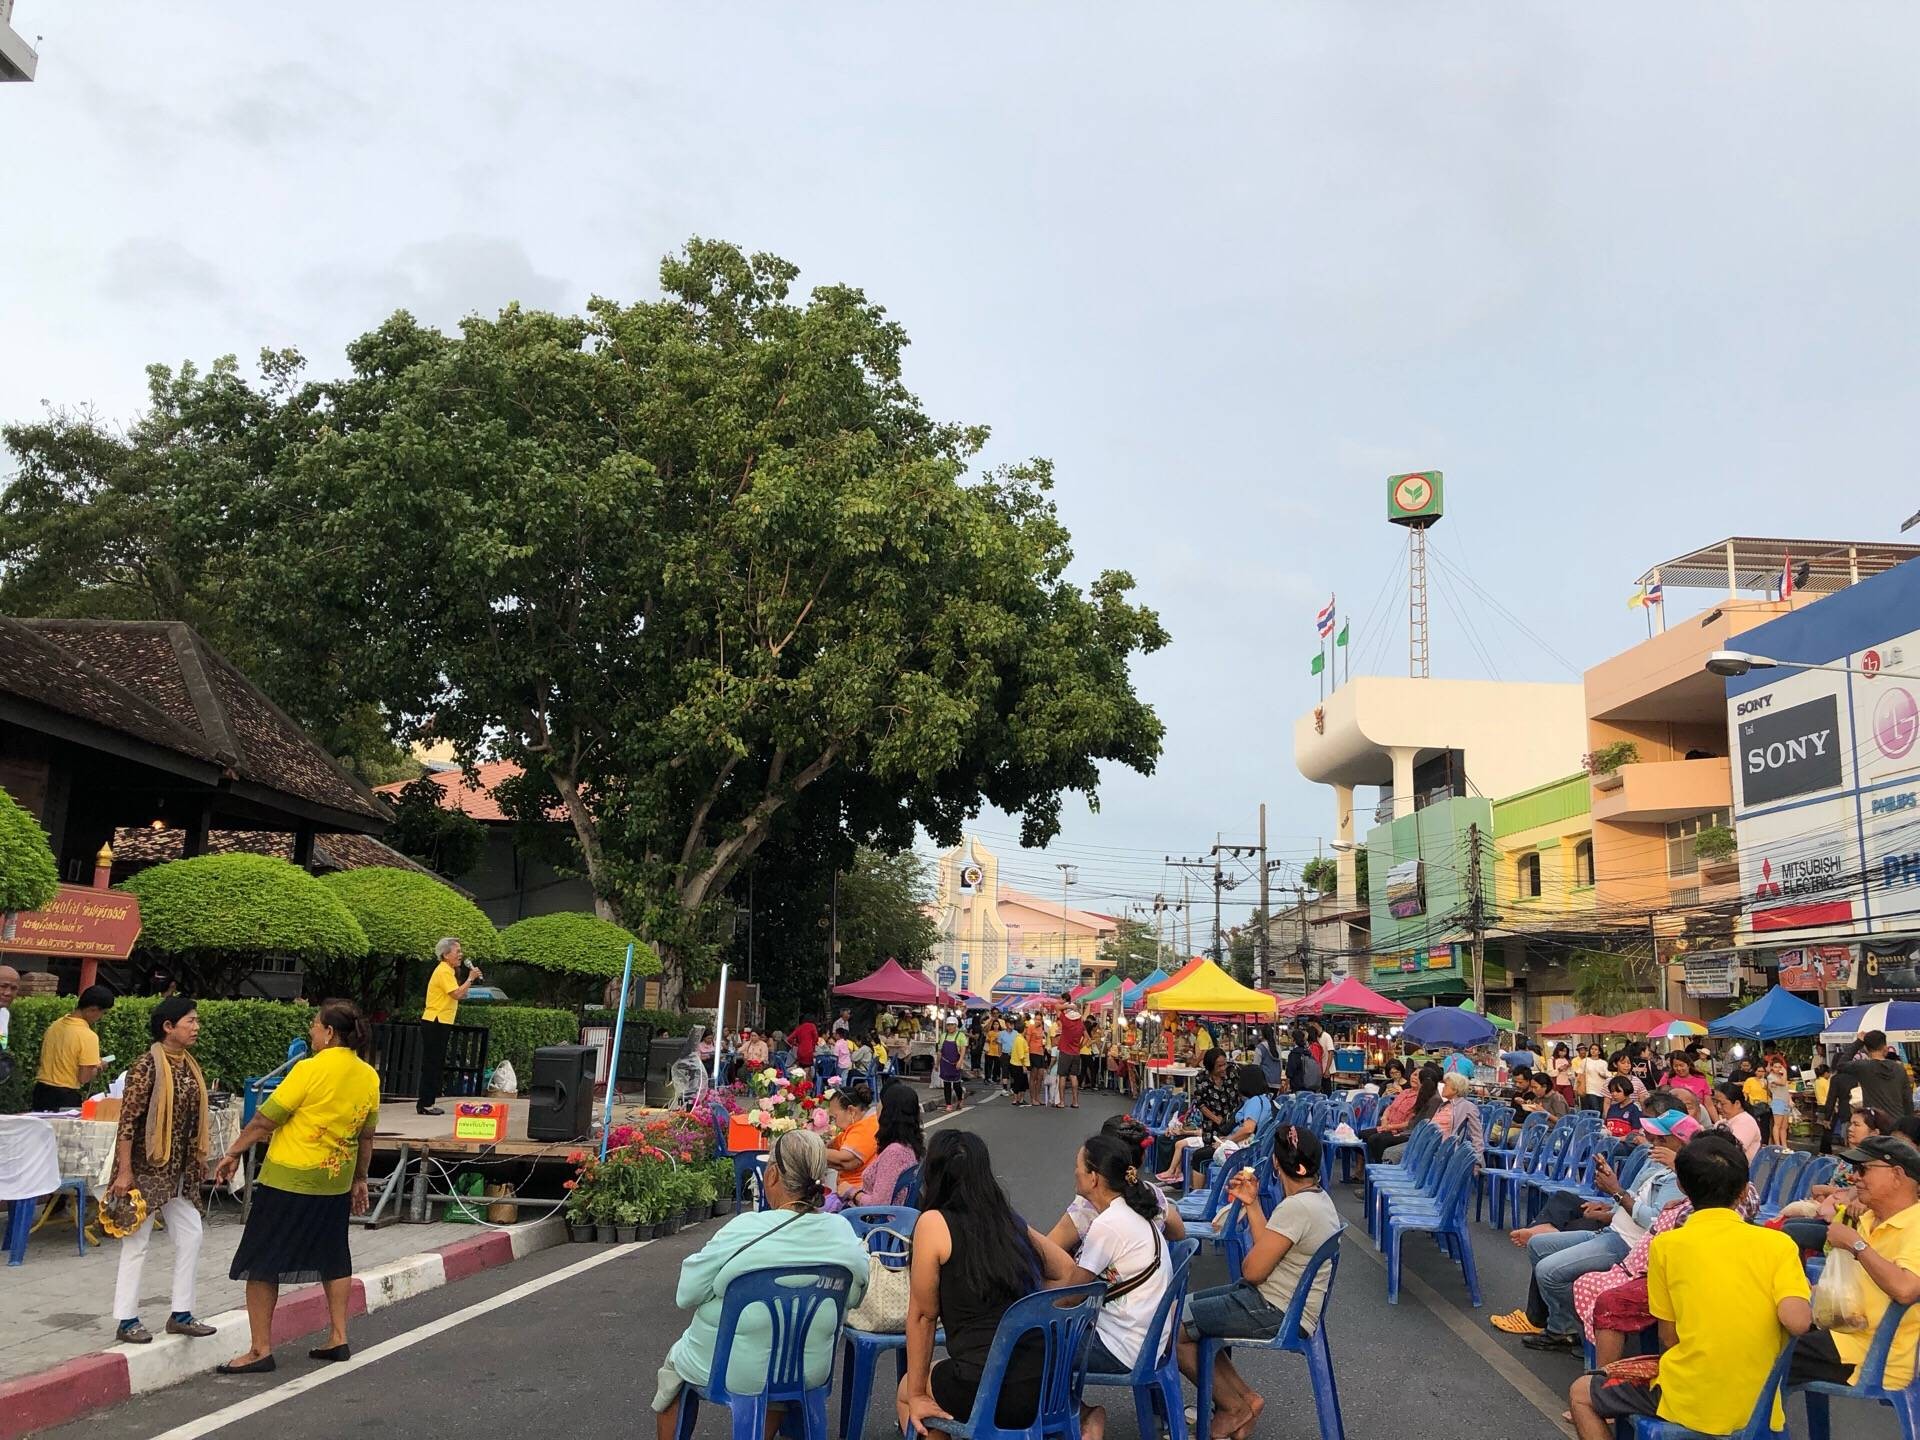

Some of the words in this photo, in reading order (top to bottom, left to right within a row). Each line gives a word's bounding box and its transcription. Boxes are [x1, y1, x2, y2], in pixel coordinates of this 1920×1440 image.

[1737, 694, 1773, 716] SONY
[1748, 729, 1830, 774] SONY
[1871, 791, 1917, 815] PHILIPS
[1781, 856, 1841, 879] MITSUBISHI
[1782, 874, 1834, 895] ELECTRIC
